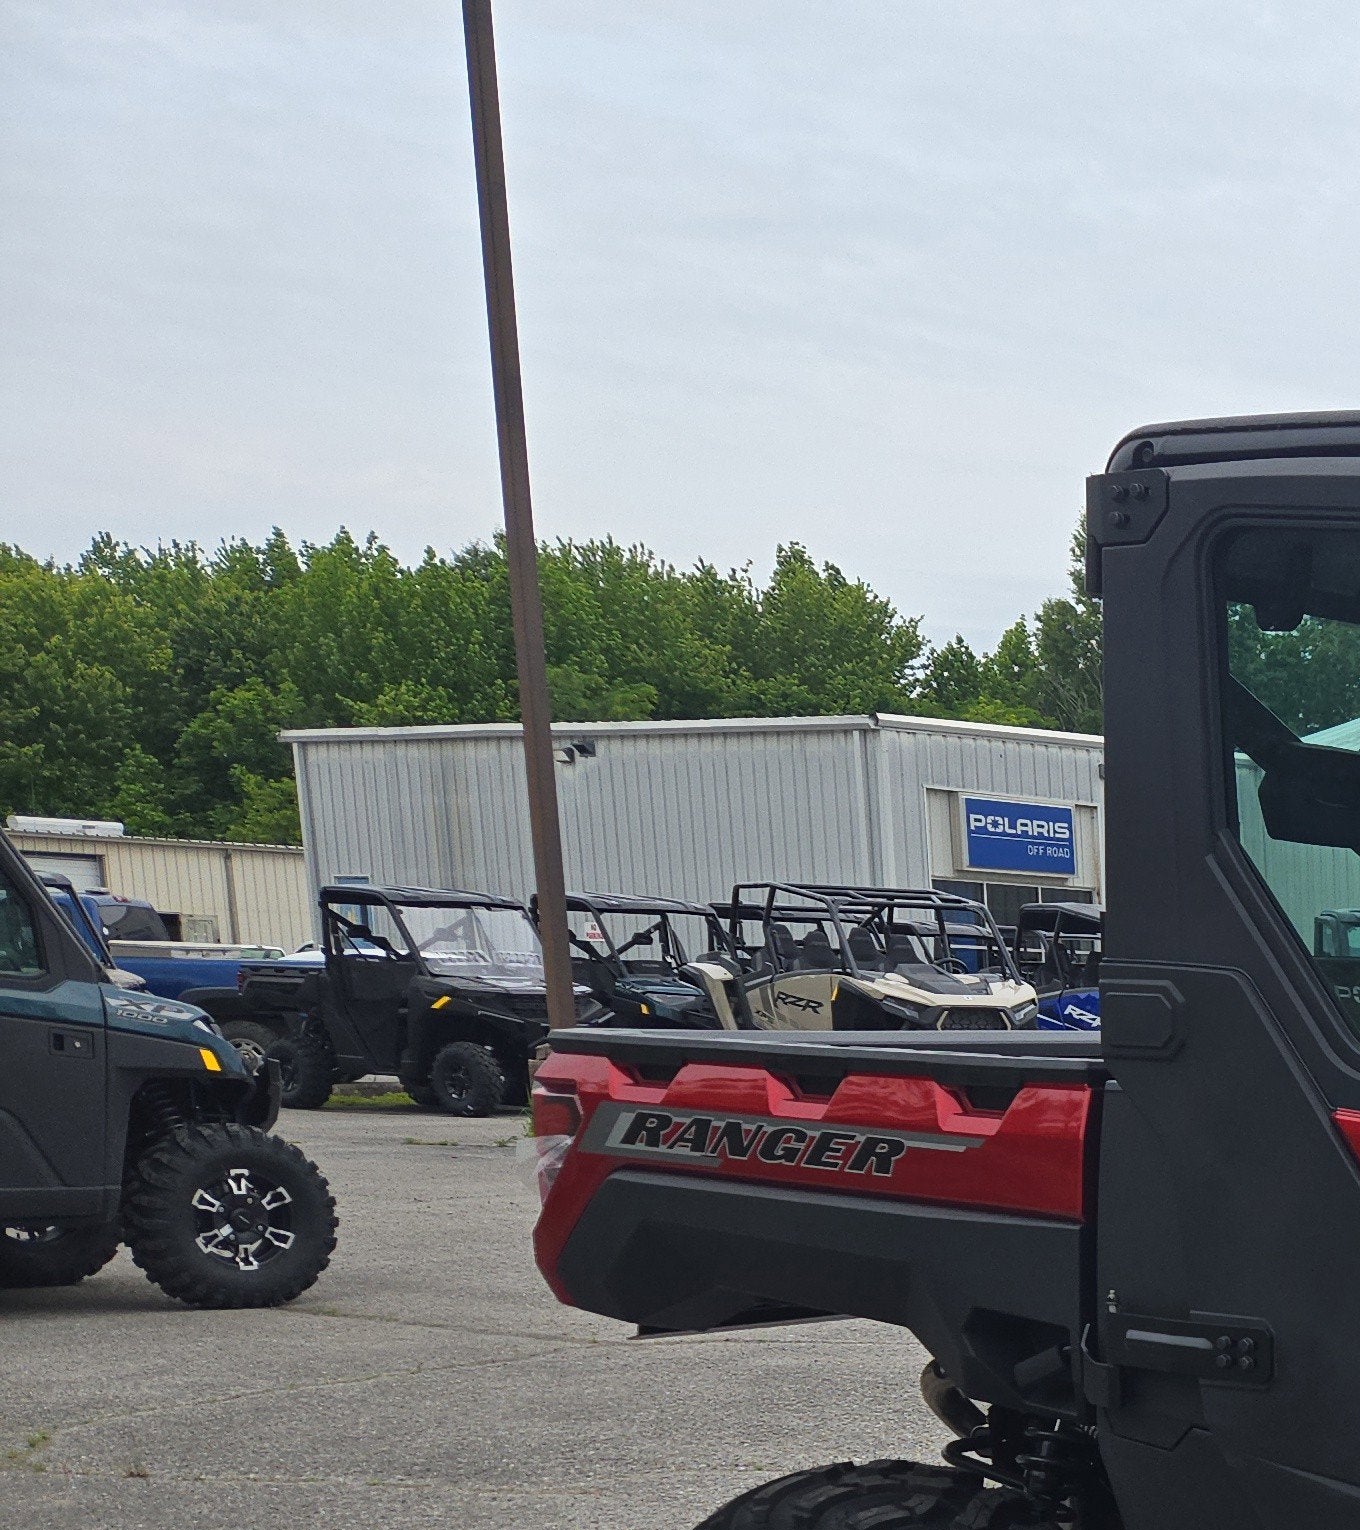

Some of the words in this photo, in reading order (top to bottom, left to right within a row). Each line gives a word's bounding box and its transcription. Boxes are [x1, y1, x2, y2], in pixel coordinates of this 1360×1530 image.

[970, 814, 1070, 839] POLARIS
[1027, 845, 1045, 856] OFF
[1047, 846, 1070, 858] ROAD
[774, 991, 825, 1014] RZR
[617, 1110, 907, 1177] RANGER
